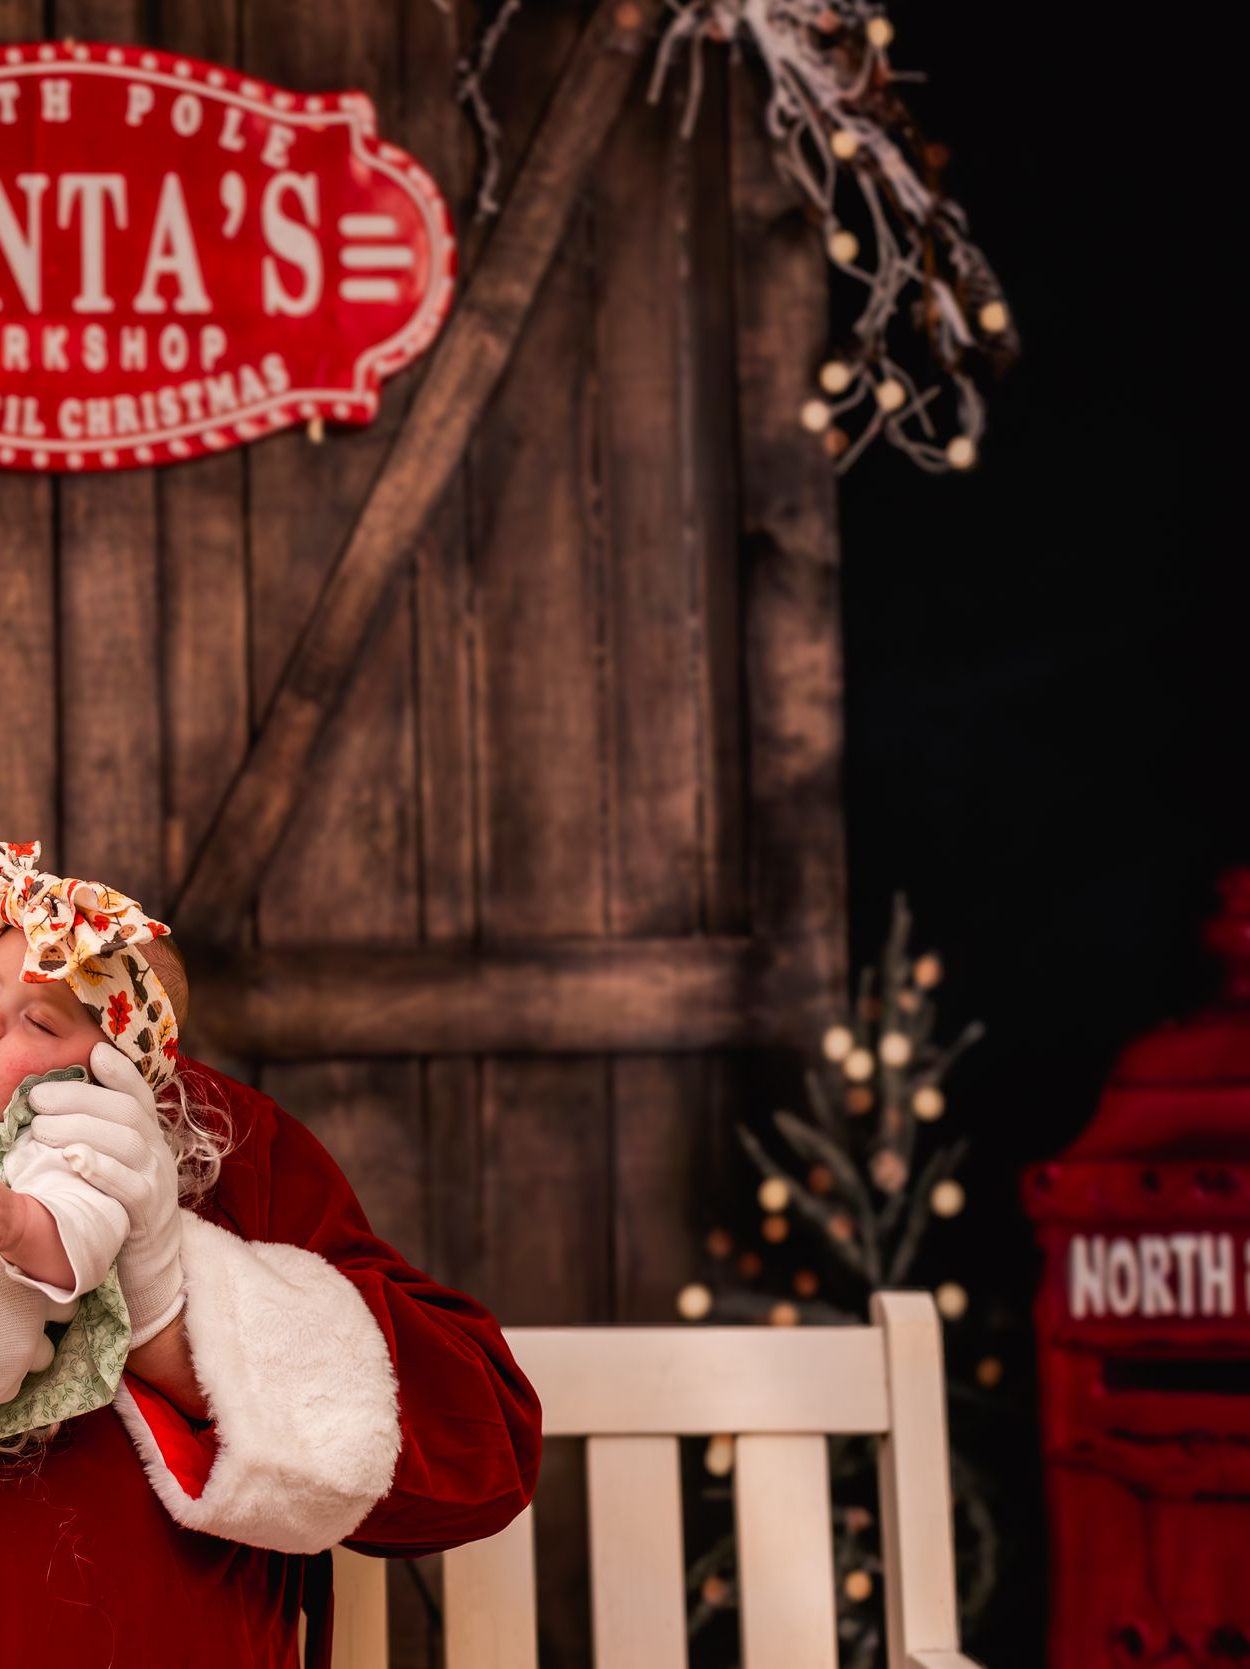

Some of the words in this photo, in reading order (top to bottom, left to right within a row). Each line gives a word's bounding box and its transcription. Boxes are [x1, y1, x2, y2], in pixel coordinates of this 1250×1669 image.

[125, 82, 296, 169] POLE
[58, 352, 291, 439] CHRISTMAS
[1070, 1231, 1235, 1320] NORTH
